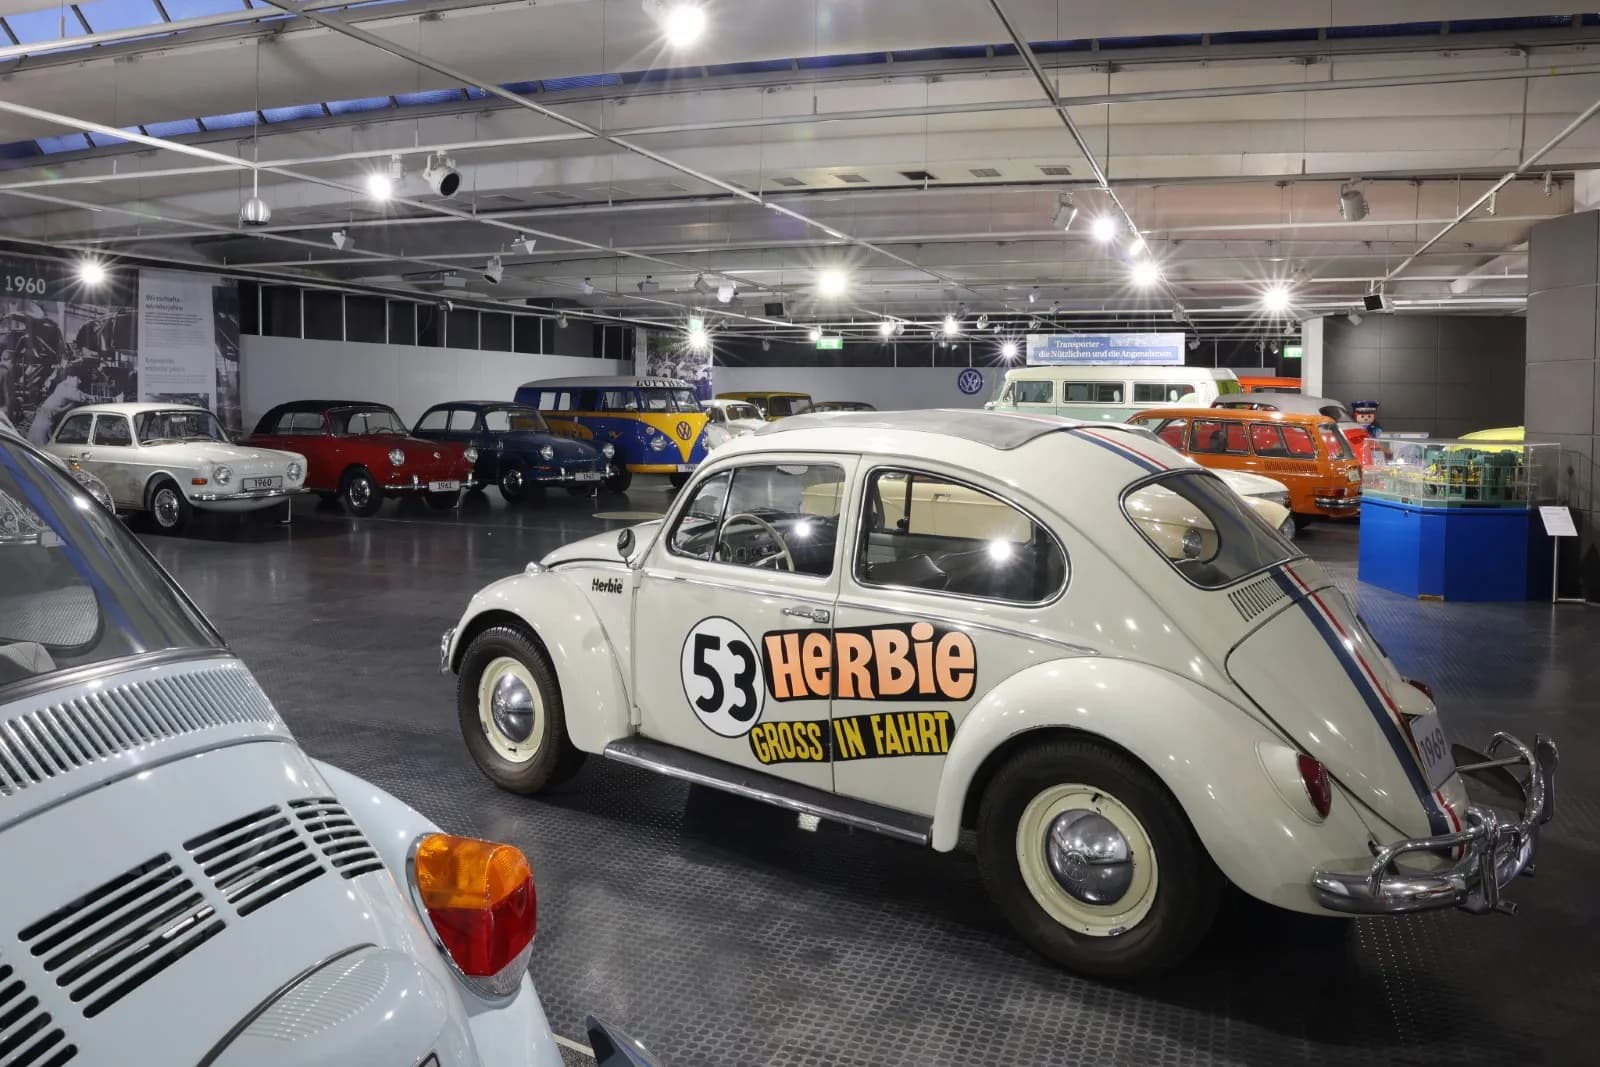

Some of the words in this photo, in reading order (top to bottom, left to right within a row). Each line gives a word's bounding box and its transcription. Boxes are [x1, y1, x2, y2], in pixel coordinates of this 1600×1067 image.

[5, 275, 46, 294] 1960
[1038, 350, 1049, 358] die
[1050, 350, 1091, 358] Nützlichen
[1092, 350, 1107, 358] und
[1108, 350, 1120, 358] die
[1056, 340, 1099, 350] Transporter
[959, 369, 982, 394] VW
[676, 421, 692, 440] VW
[254, 478, 272, 487] 1960
[592, 577, 623, 594] Herbie
[693, 633, 757, 722] 53
[751, 721, 822, 763] GROSS
[834, 717, 867, 759] IN
[872, 711, 950, 755] FAHRT
[1420, 727, 1446, 768] 1969
